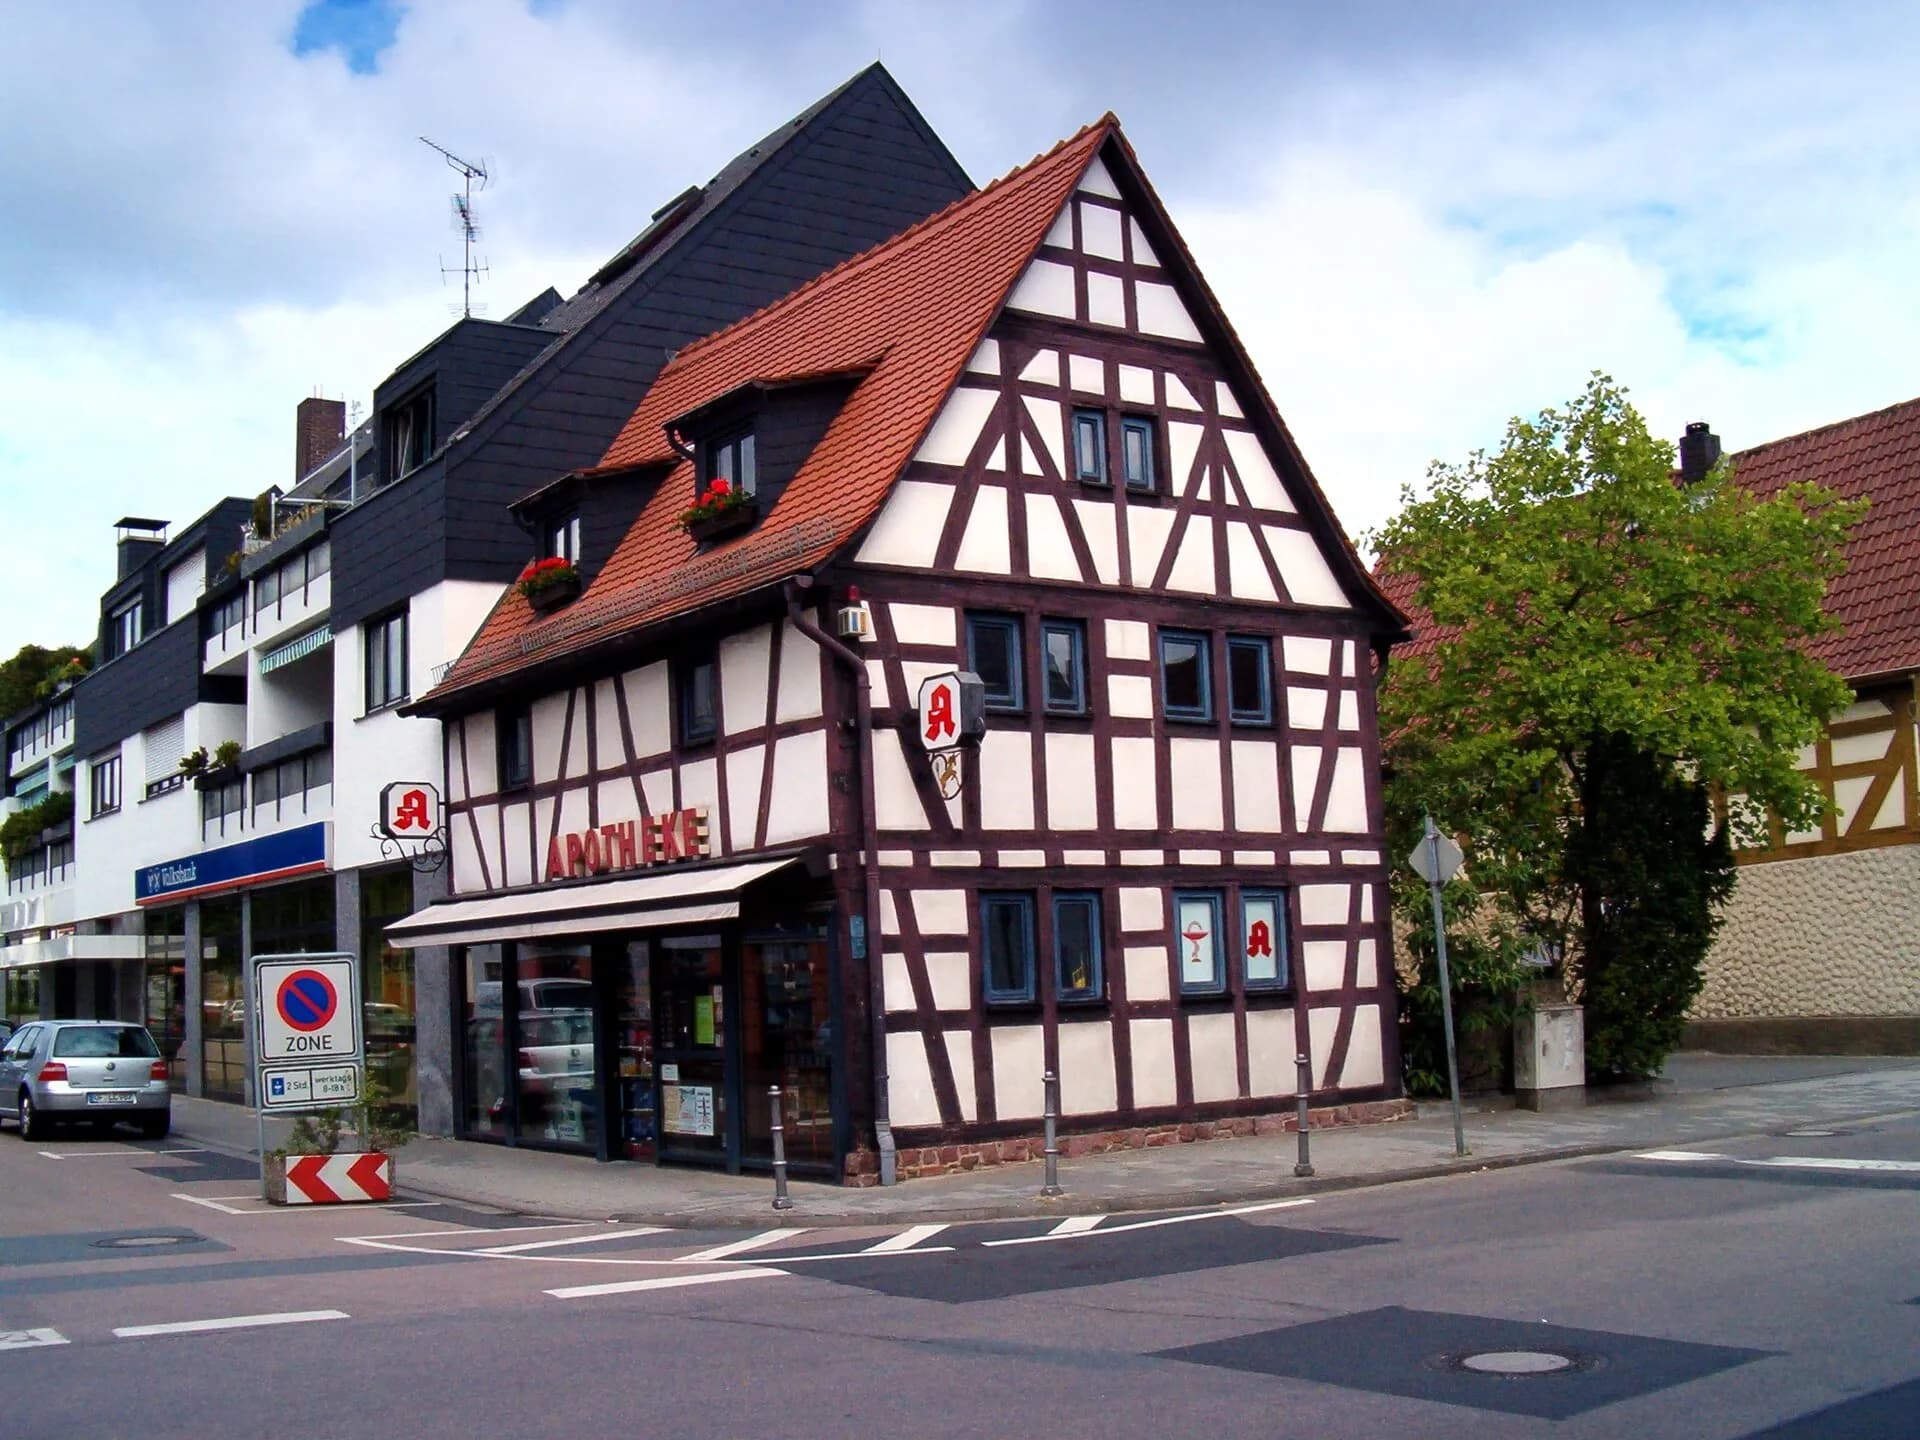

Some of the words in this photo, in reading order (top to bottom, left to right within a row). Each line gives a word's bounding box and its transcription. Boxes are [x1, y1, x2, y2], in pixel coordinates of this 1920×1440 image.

[925, 684, 956, 741] A
[393, 789, 431, 830] A
[545, 808, 703, 880] APOTHEKE
[1246, 920, 1272, 957] A
[286, 1035, 332, 1052] ZONE
[286, 1081, 292, 1090] 2
